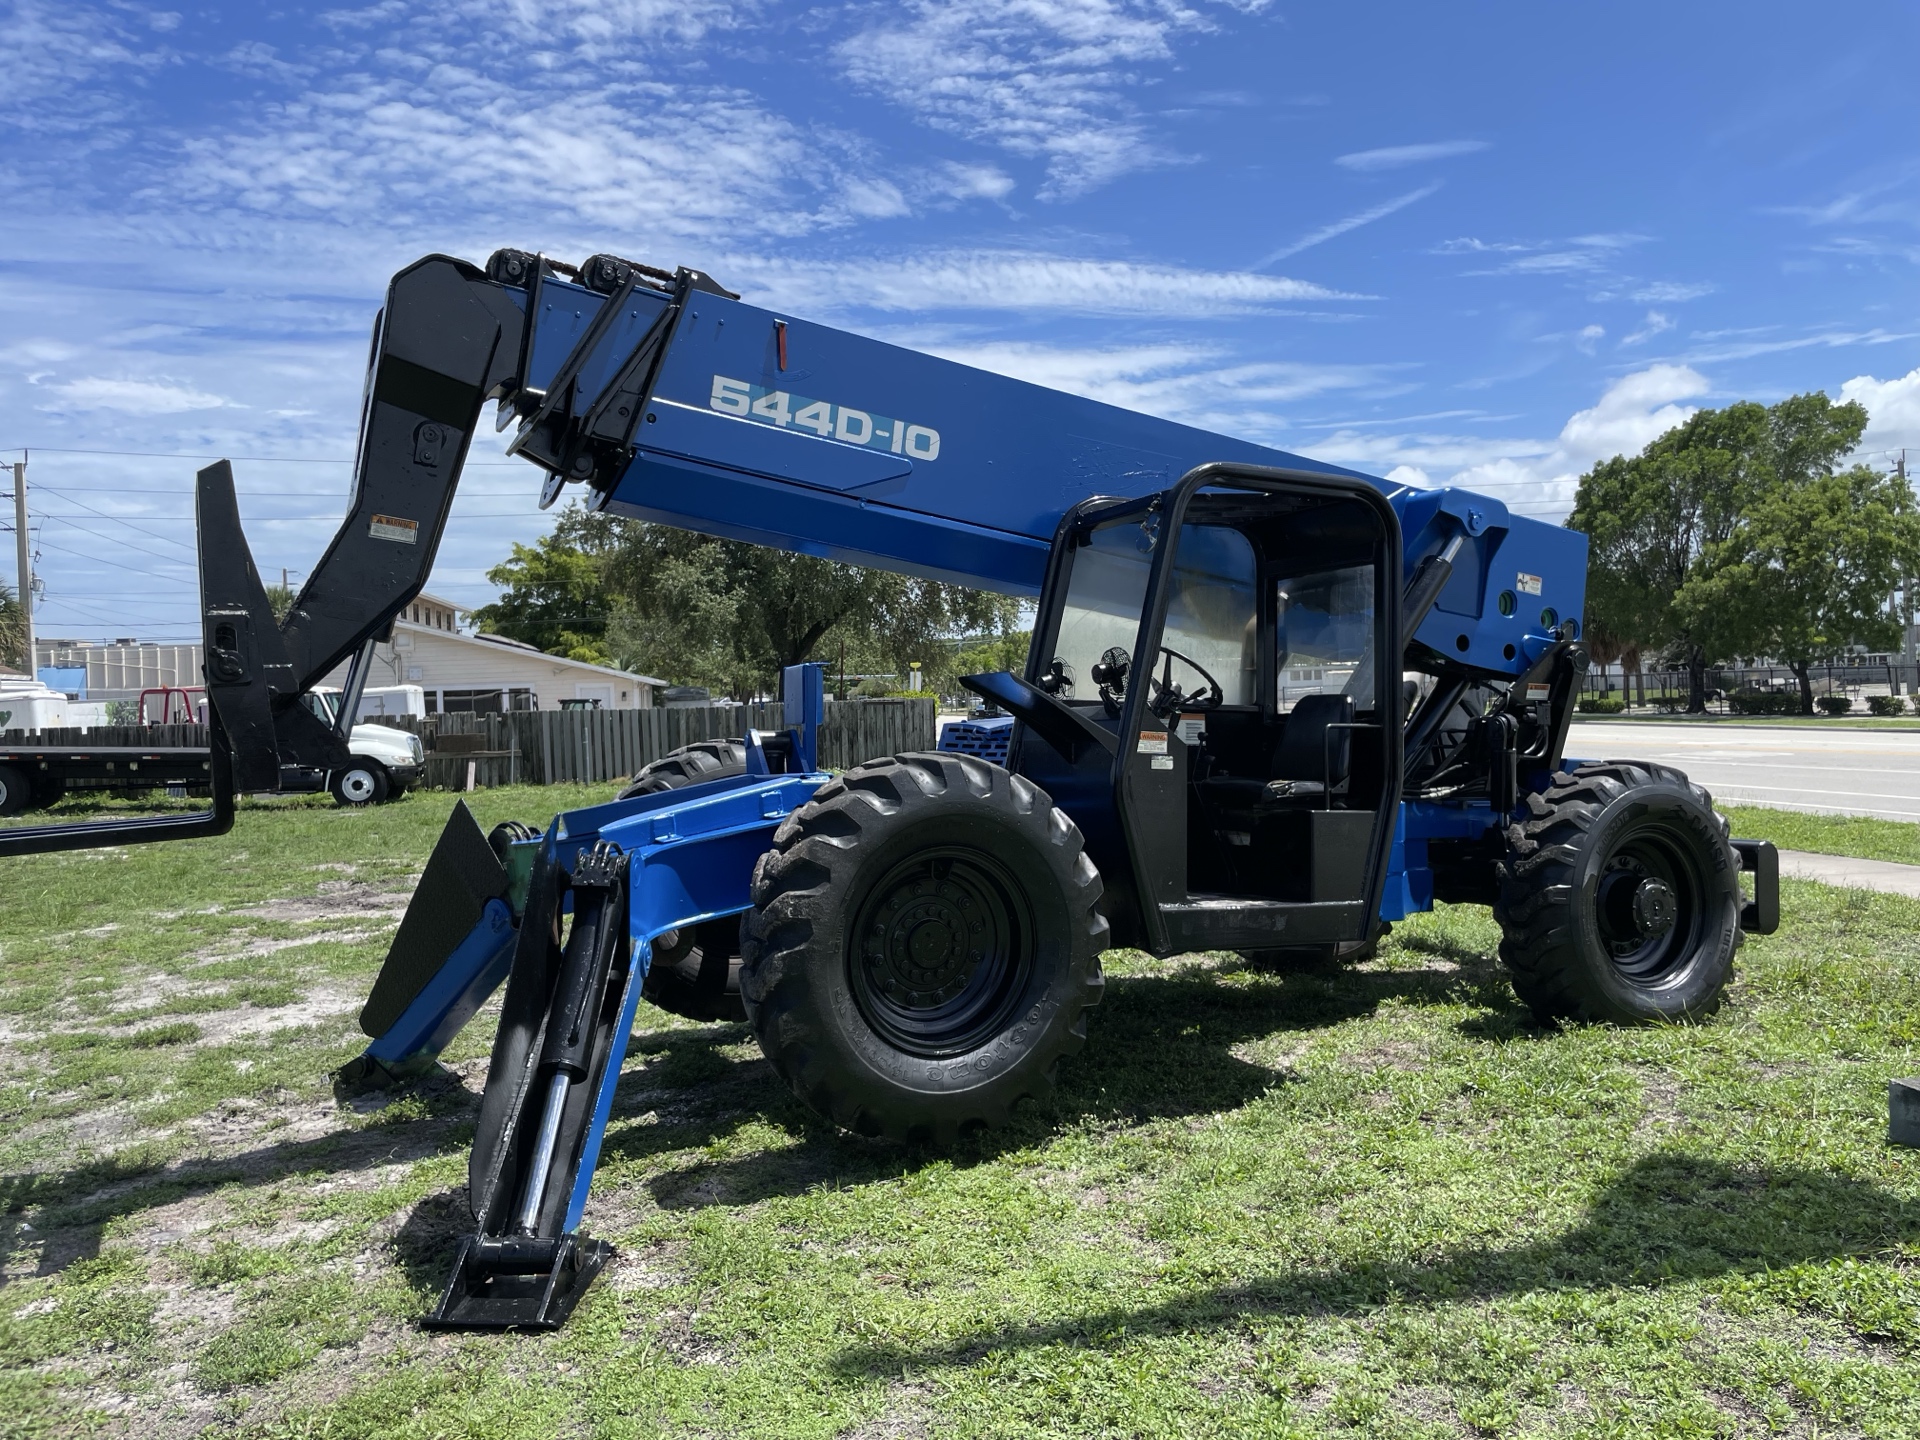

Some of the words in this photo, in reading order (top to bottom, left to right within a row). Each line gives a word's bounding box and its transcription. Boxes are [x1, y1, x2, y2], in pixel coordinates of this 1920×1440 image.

[710, 375, 940, 461] 544D-10
[385, 517, 412, 530] WARNING
[1141, 733, 1166, 741] WARNING
